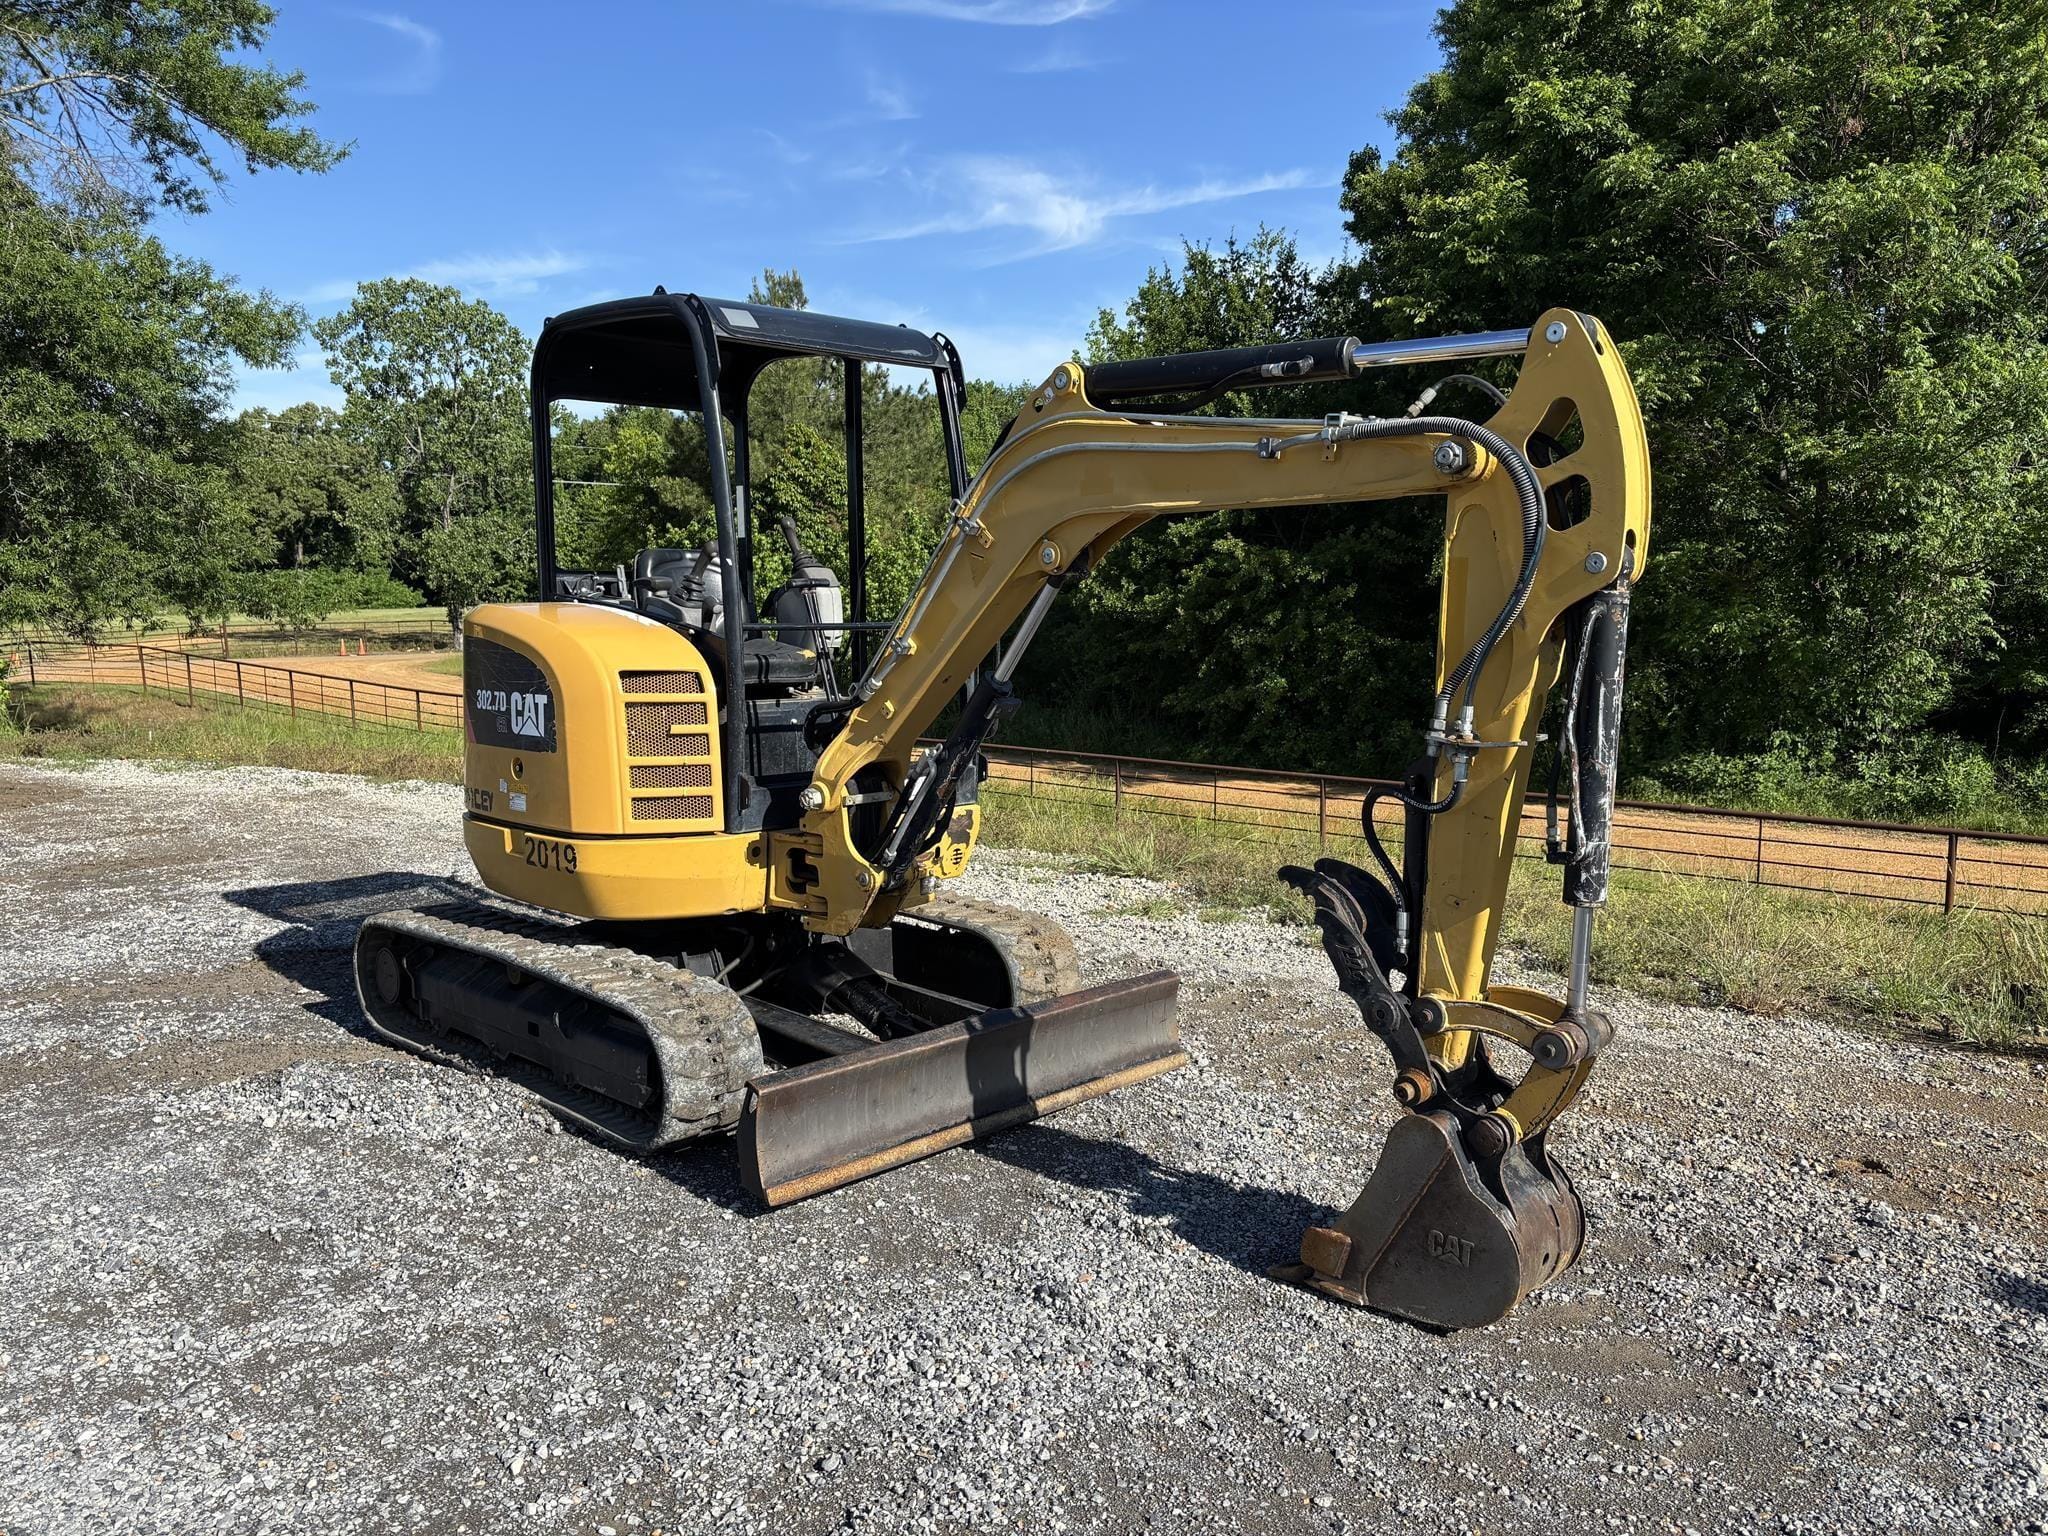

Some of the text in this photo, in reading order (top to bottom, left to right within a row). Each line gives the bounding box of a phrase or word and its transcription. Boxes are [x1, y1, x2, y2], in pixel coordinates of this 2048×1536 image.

[476, 689, 507, 712] 302.7D
[510, 691, 548, 738] CAT
[525, 837, 578, 874] 2019
[1428, 1229, 1475, 1268] CAT
